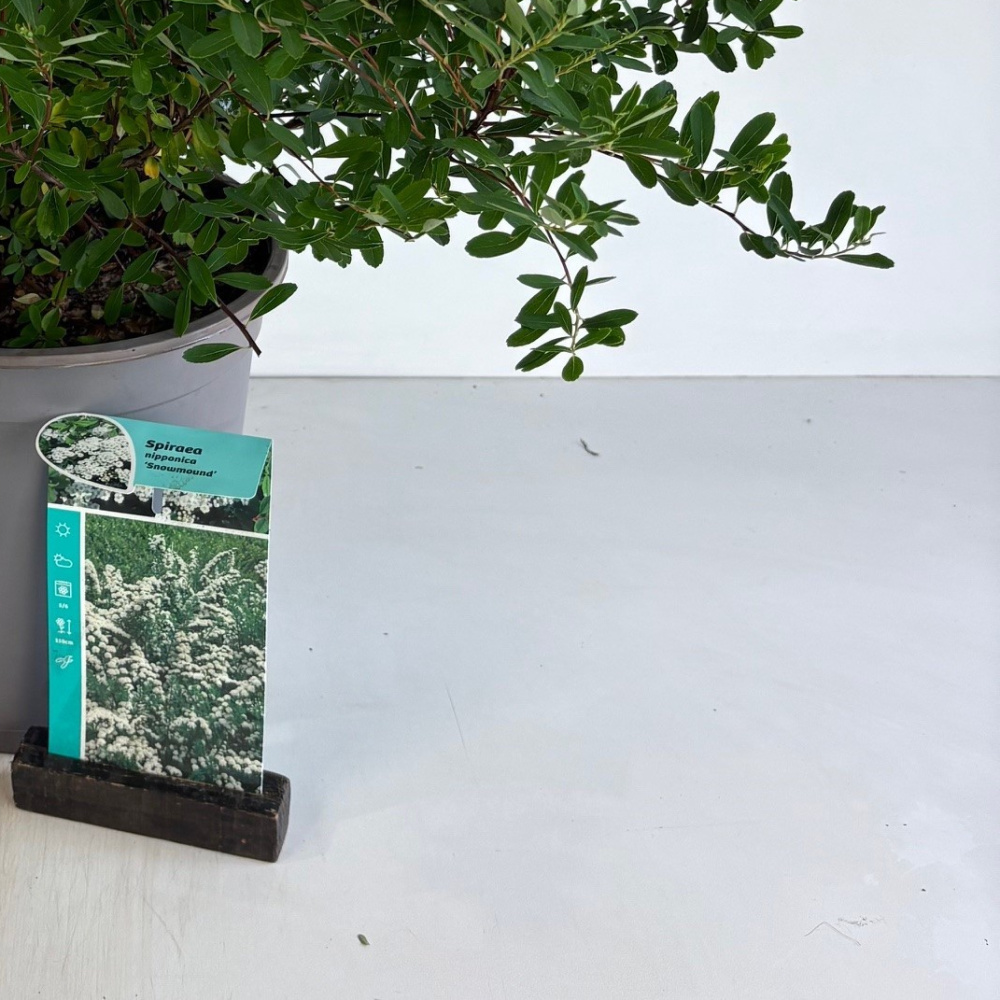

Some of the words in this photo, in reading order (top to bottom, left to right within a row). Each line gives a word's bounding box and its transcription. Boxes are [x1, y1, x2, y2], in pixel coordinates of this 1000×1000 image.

[145, 439, 203, 456] Spiraea
[145, 452, 197, 465] nipponica
[144, 461, 218, 478] 'Snowmound'
